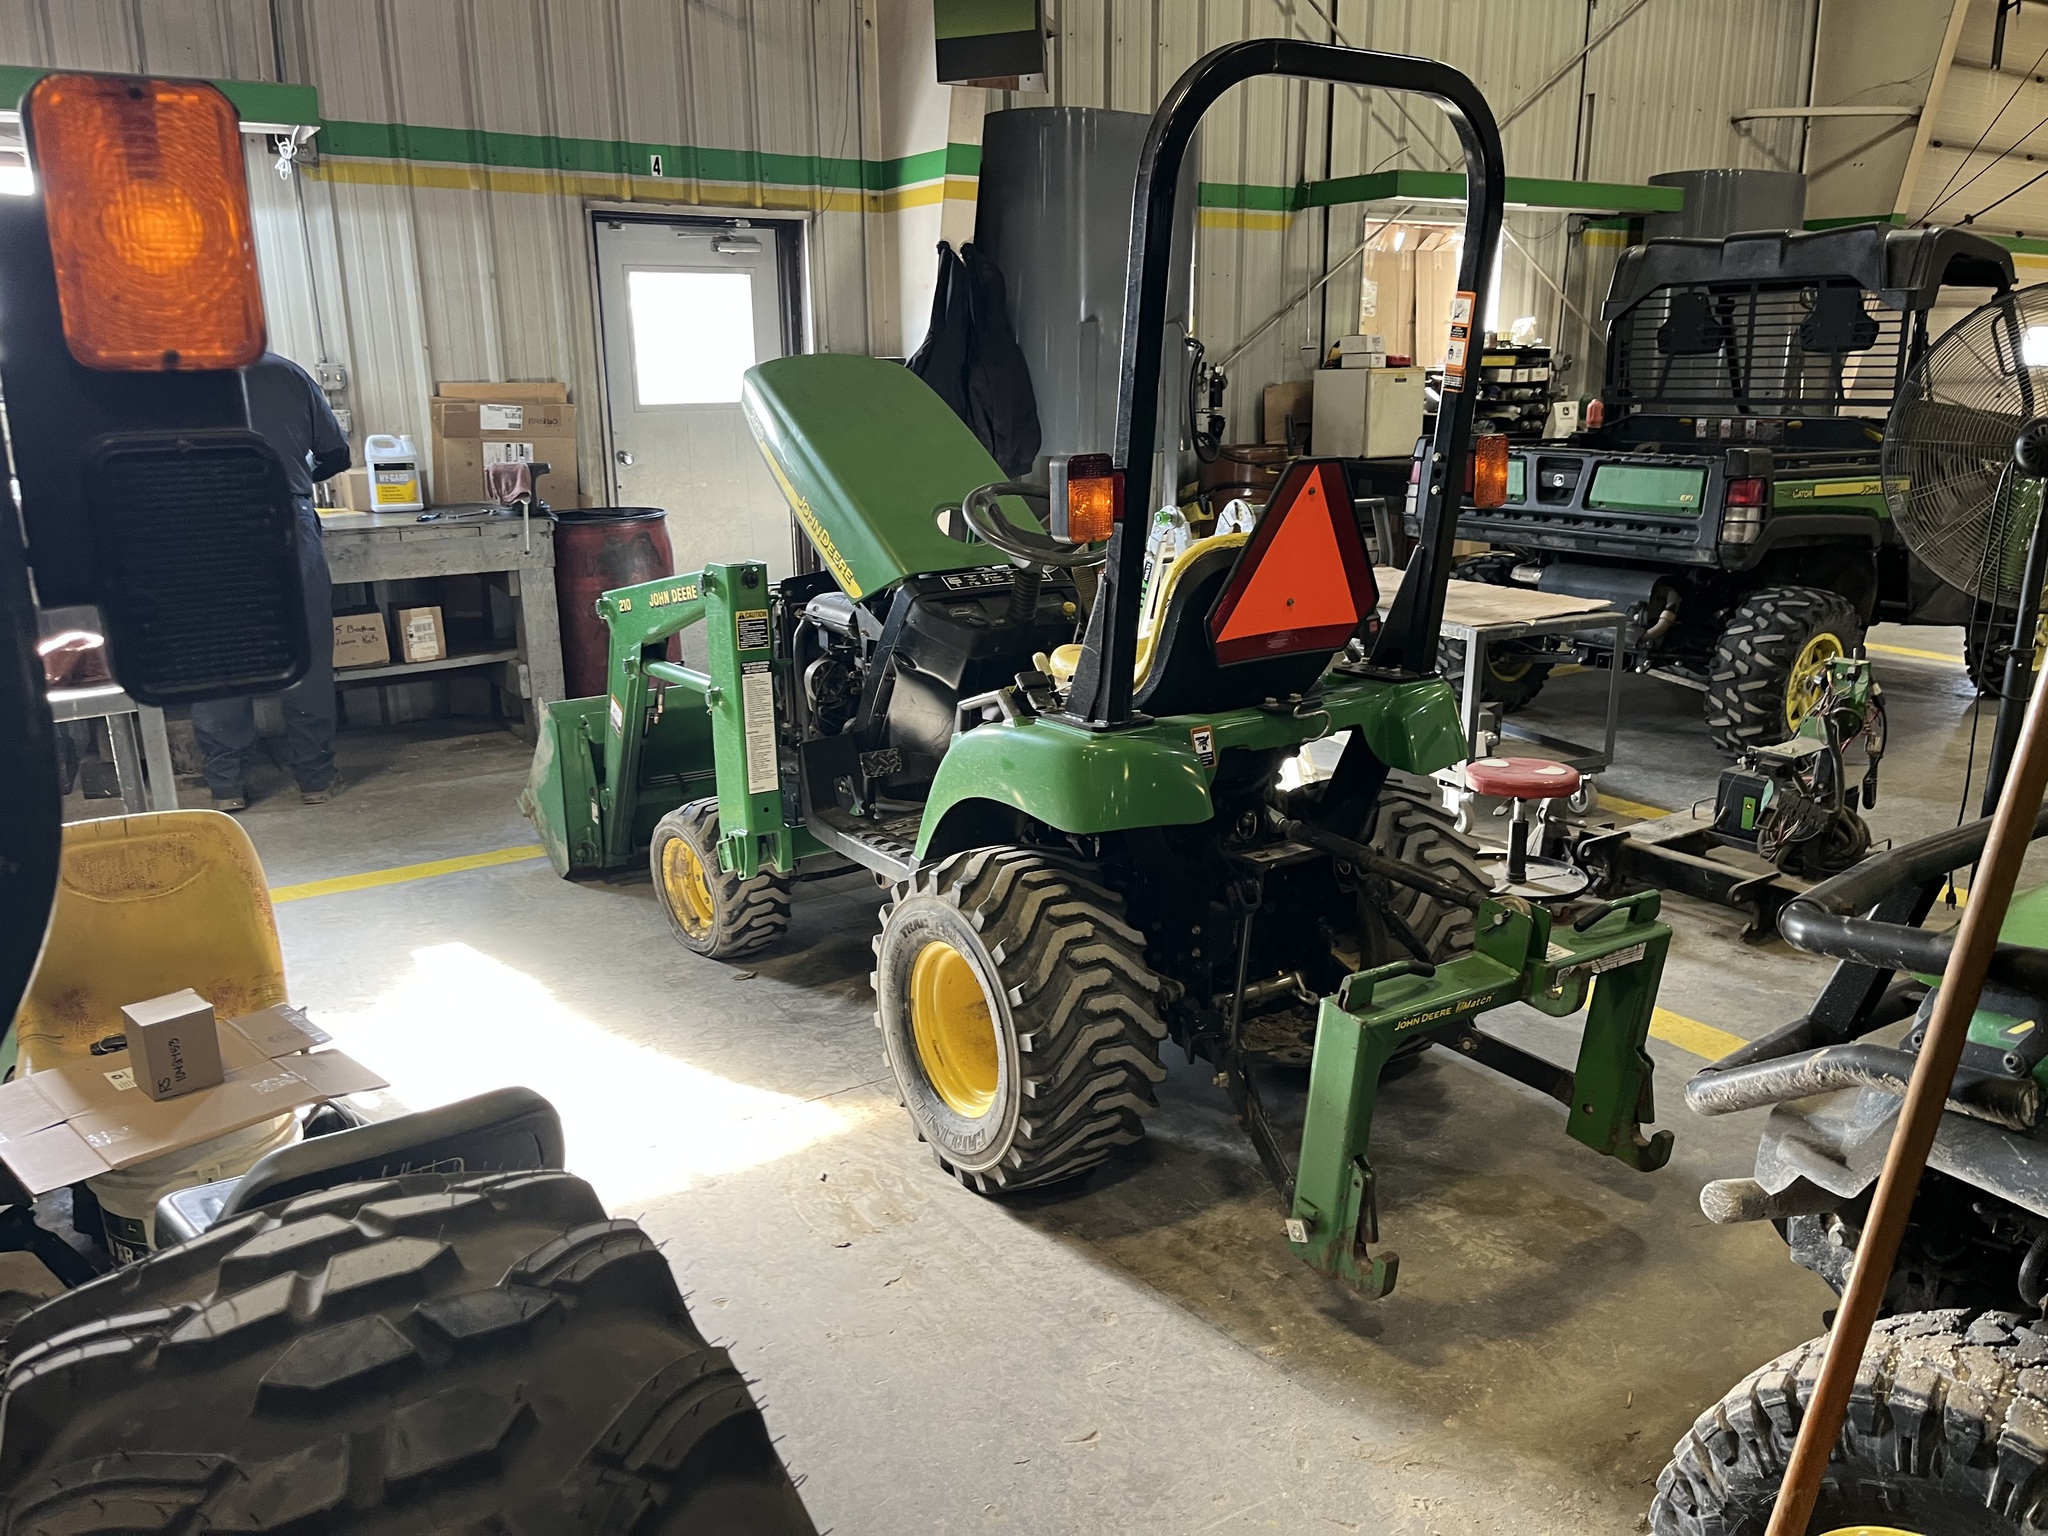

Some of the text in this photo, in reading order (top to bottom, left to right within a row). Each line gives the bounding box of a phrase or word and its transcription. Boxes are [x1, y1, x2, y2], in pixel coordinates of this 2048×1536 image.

[653, 156, 661, 176] 4
[379, 473, 409, 482] HY-GARD
[797, 495, 855, 585] JOHN DEERE
[618, 598, 632, 612] 210
[649, 584, 698, 607] JOHN DEERE
[745, 611, 767, 619] CAUTION
[1394, 1016, 1420, 1031] JOHN
[1421, 1006, 1453, 1023] DEERE
[914, 1089, 987, 1152] CARLISLE
